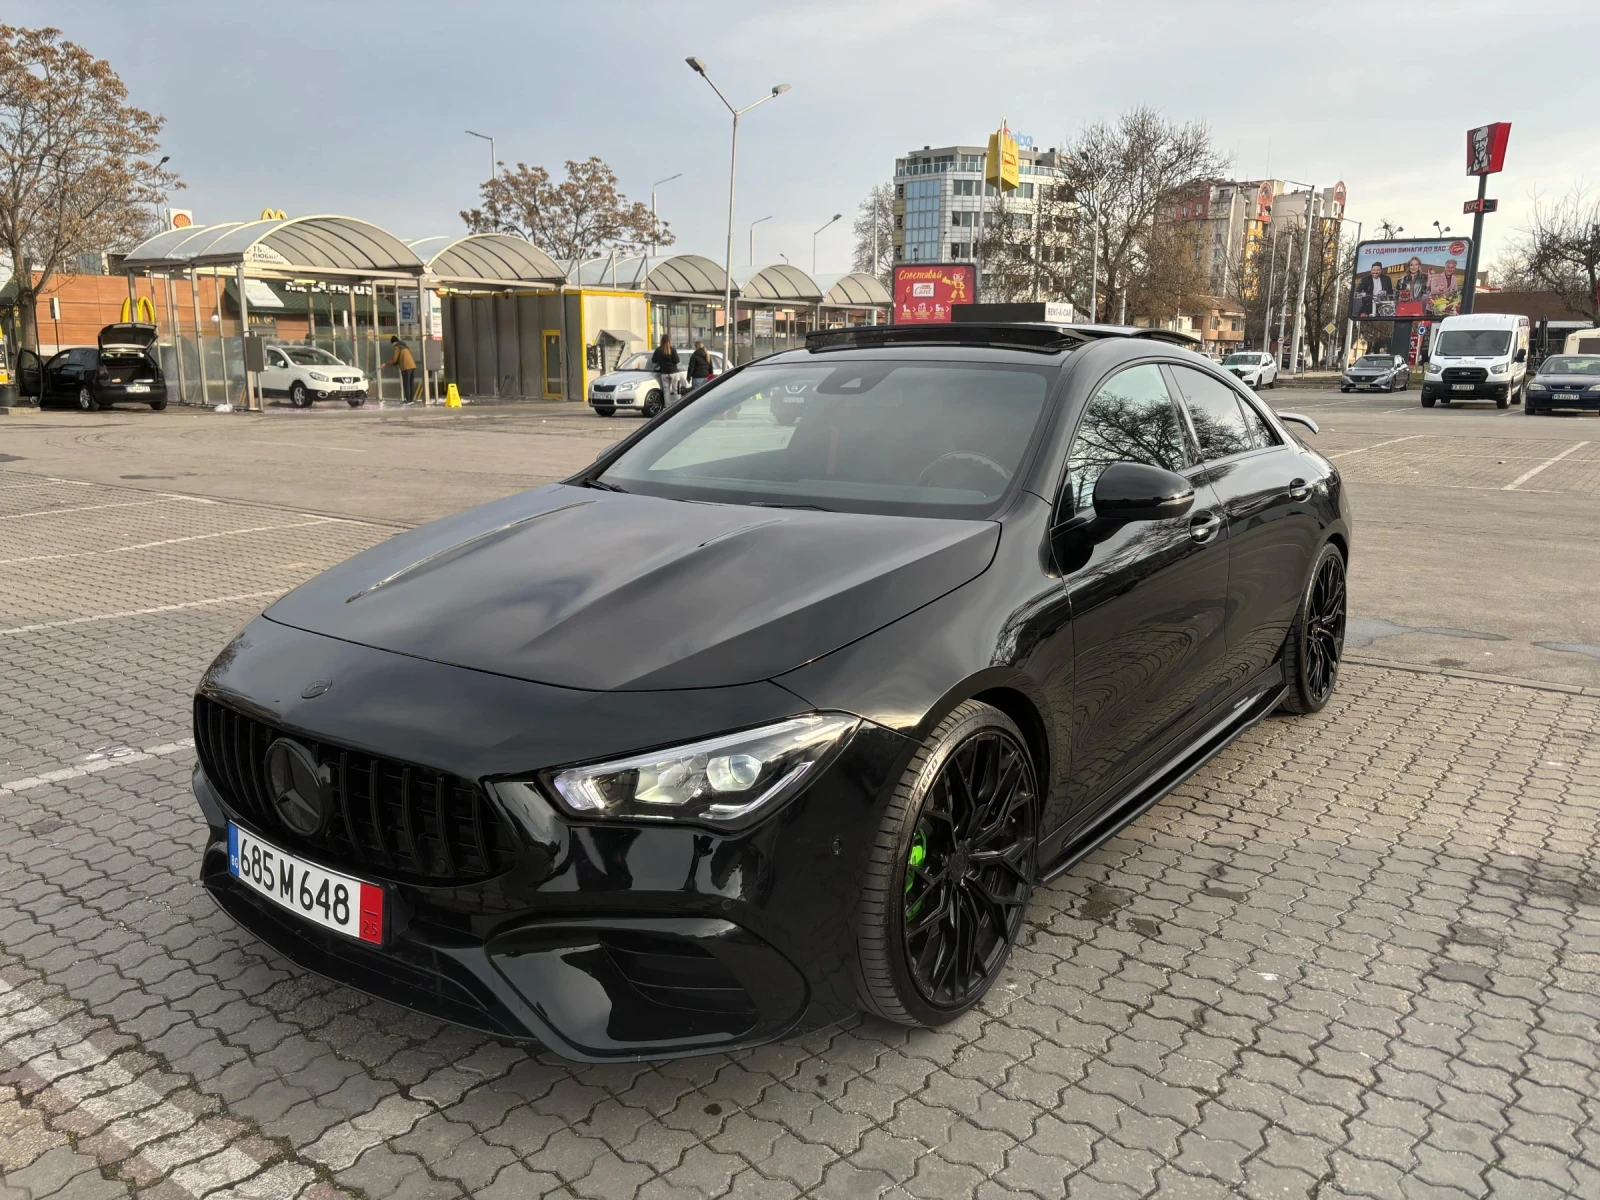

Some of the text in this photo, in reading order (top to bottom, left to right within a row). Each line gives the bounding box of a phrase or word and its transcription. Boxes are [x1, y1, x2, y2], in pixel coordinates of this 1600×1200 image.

[1465, 202, 1479, 212] KFC
[1373, 247, 1397, 255] ГОДИНИ
[1423, 245, 1432, 253] ДО
[899, 269, 943, 281] Спестявай
[1047, 307, 1072, 317] RENT-A-CAR
[231, 855, 239, 869] BG
[240, 838, 350, 926] 685 M 648
[363, 920, 378, 937] 25
